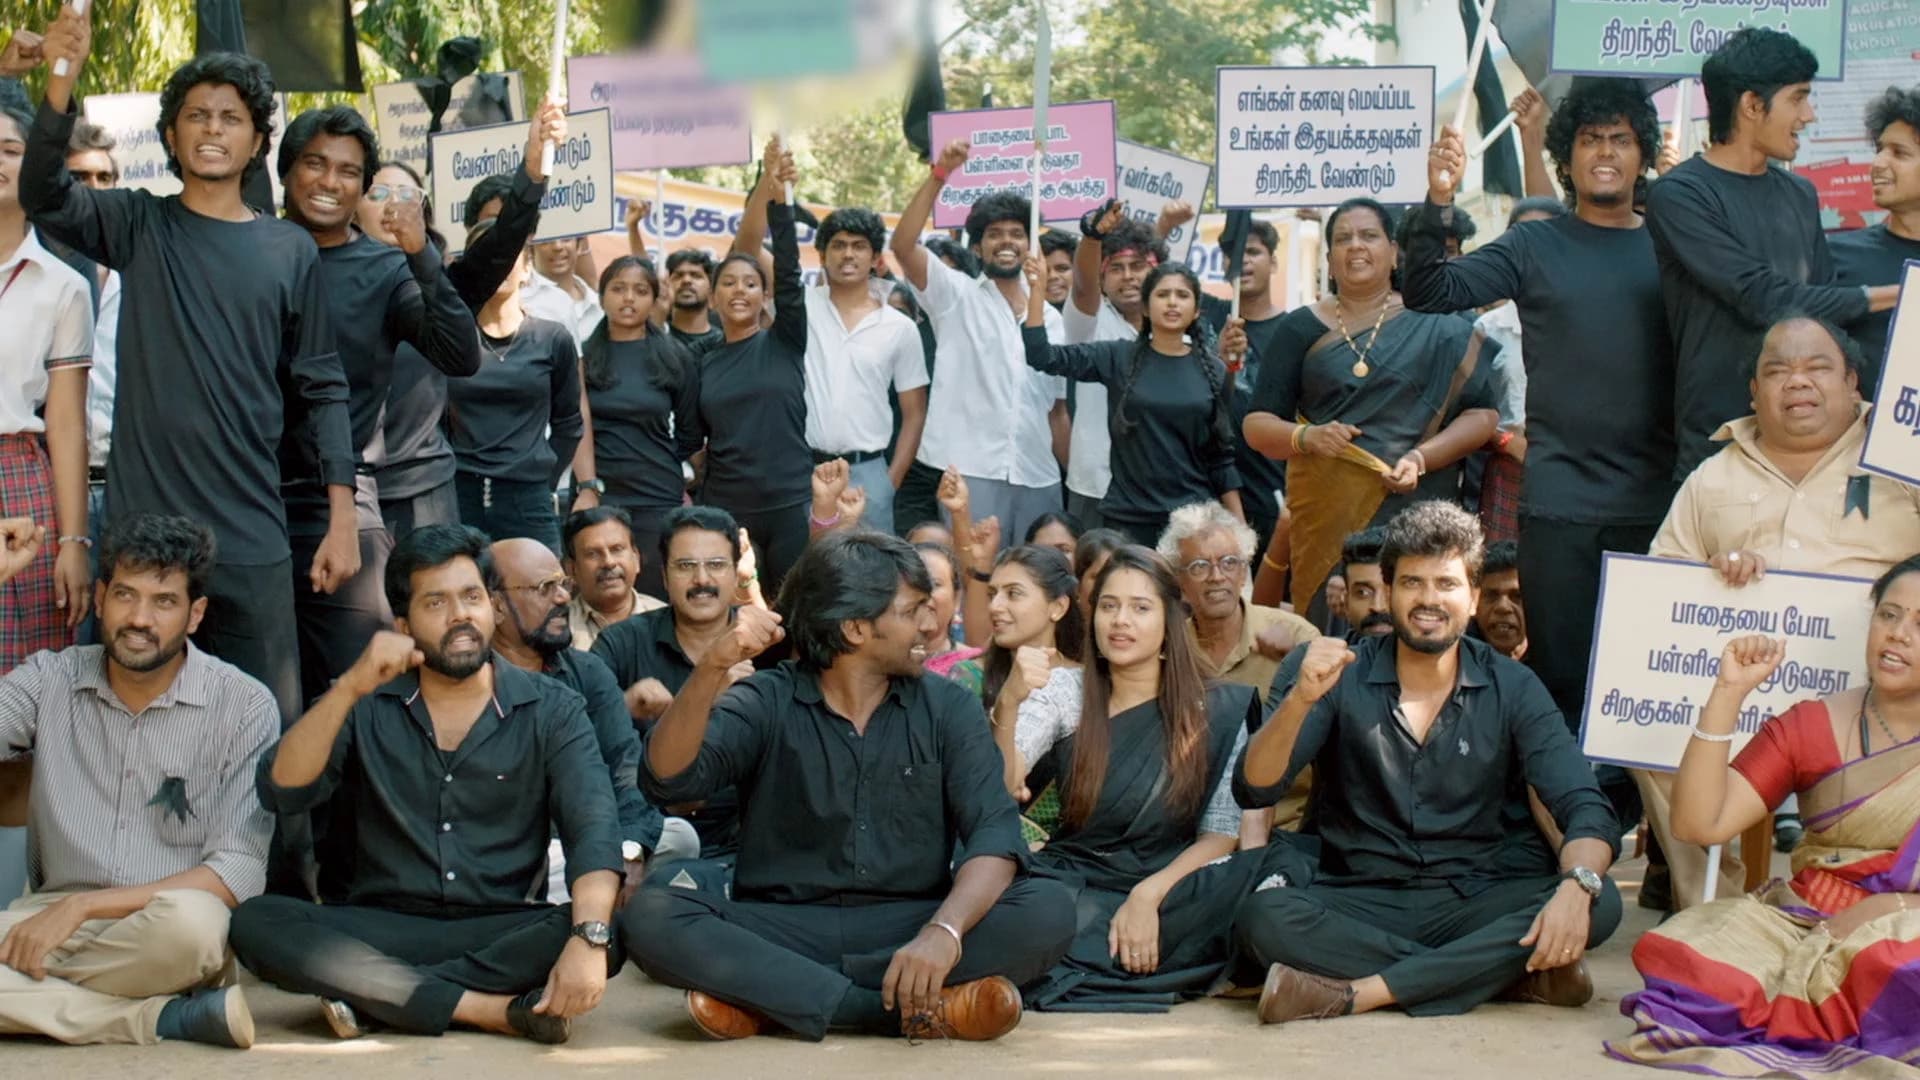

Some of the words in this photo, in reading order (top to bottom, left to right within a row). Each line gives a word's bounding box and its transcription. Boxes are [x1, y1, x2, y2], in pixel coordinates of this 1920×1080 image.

[1601, 18, 1684, 58] திறந்திட
[1238, 84, 1295, 112] எங்கள்
[1299, 90, 1344, 116] கனவு
[1348, 83, 1415, 111] மெய்ப்பட
[1230, 124, 1290, 151] உங்கள்
[1294, 122, 1422, 155] இதயக்கதவுகள்
[453, 144, 520, 181] வேண்டும்
[1255, 163, 1316, 195] திறந்திட
[1320, 161, 1396, 194] வேண்டும்
[1671, 601, 1777, 635] பாதையை
[1782, 606, 1836, 639] போட
[1601, 688, 1694, 726] சிறகுகள்
